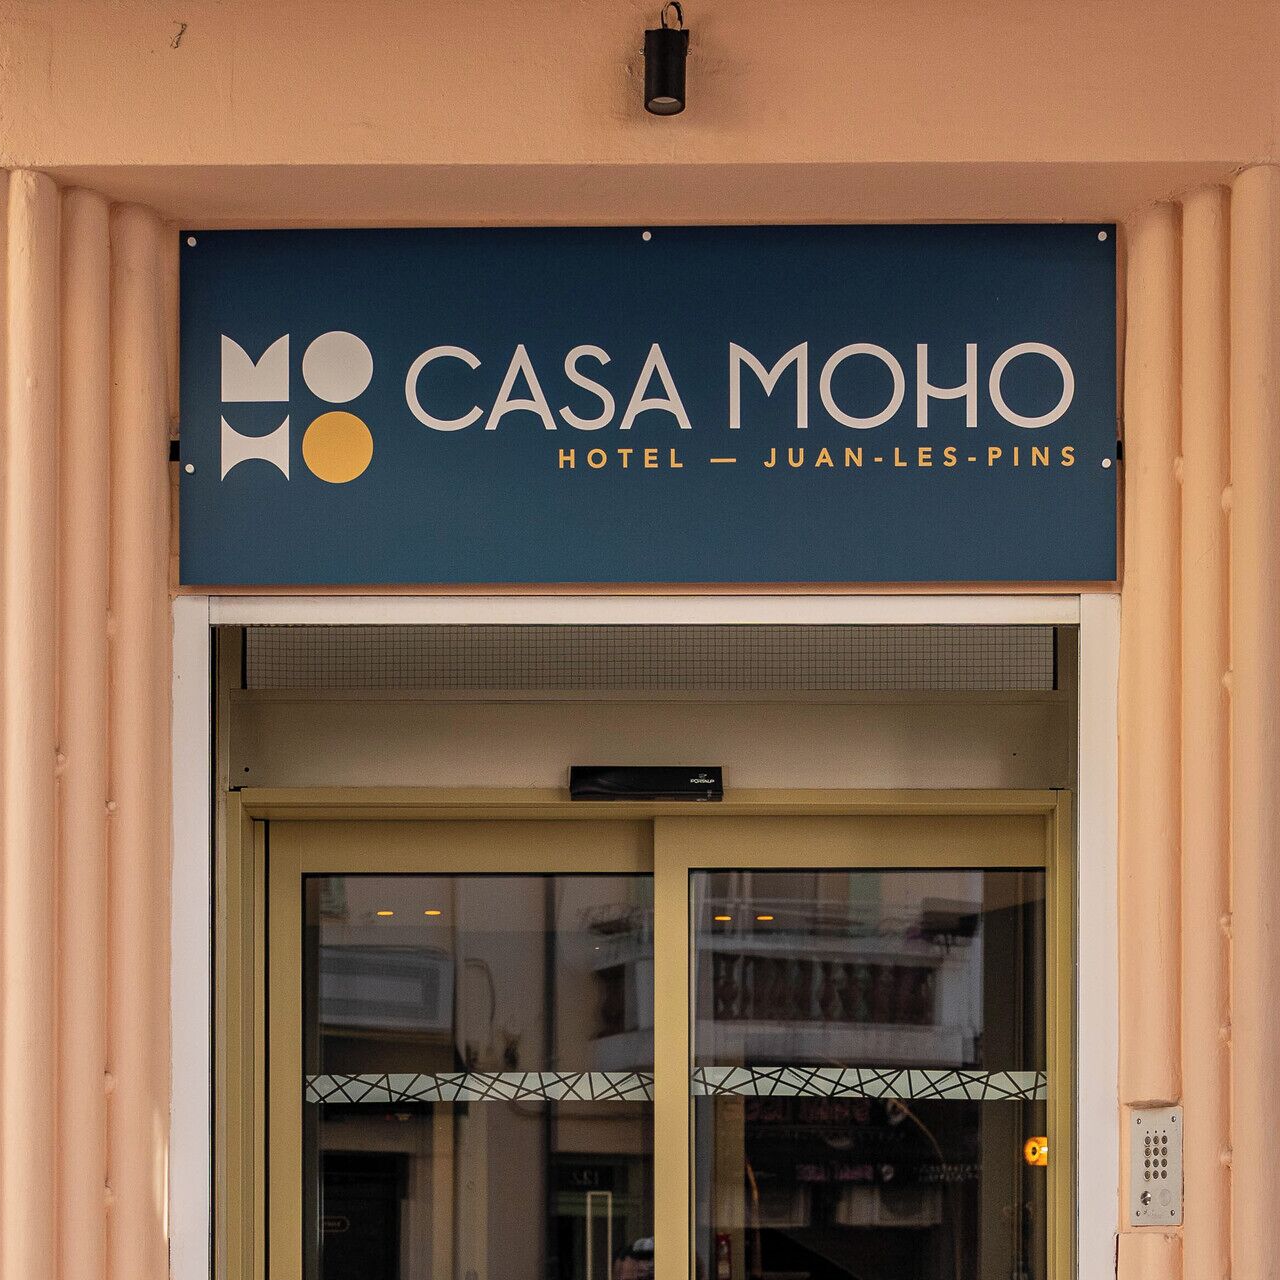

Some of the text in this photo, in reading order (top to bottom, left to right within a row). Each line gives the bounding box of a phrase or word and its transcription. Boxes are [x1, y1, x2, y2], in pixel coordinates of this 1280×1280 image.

[405, 342, 1075, 431] CASA MOHO
[558, 447, 684, 469] HOTEL
[763, 446, 1075, 468] JUAN-LES-PINS
